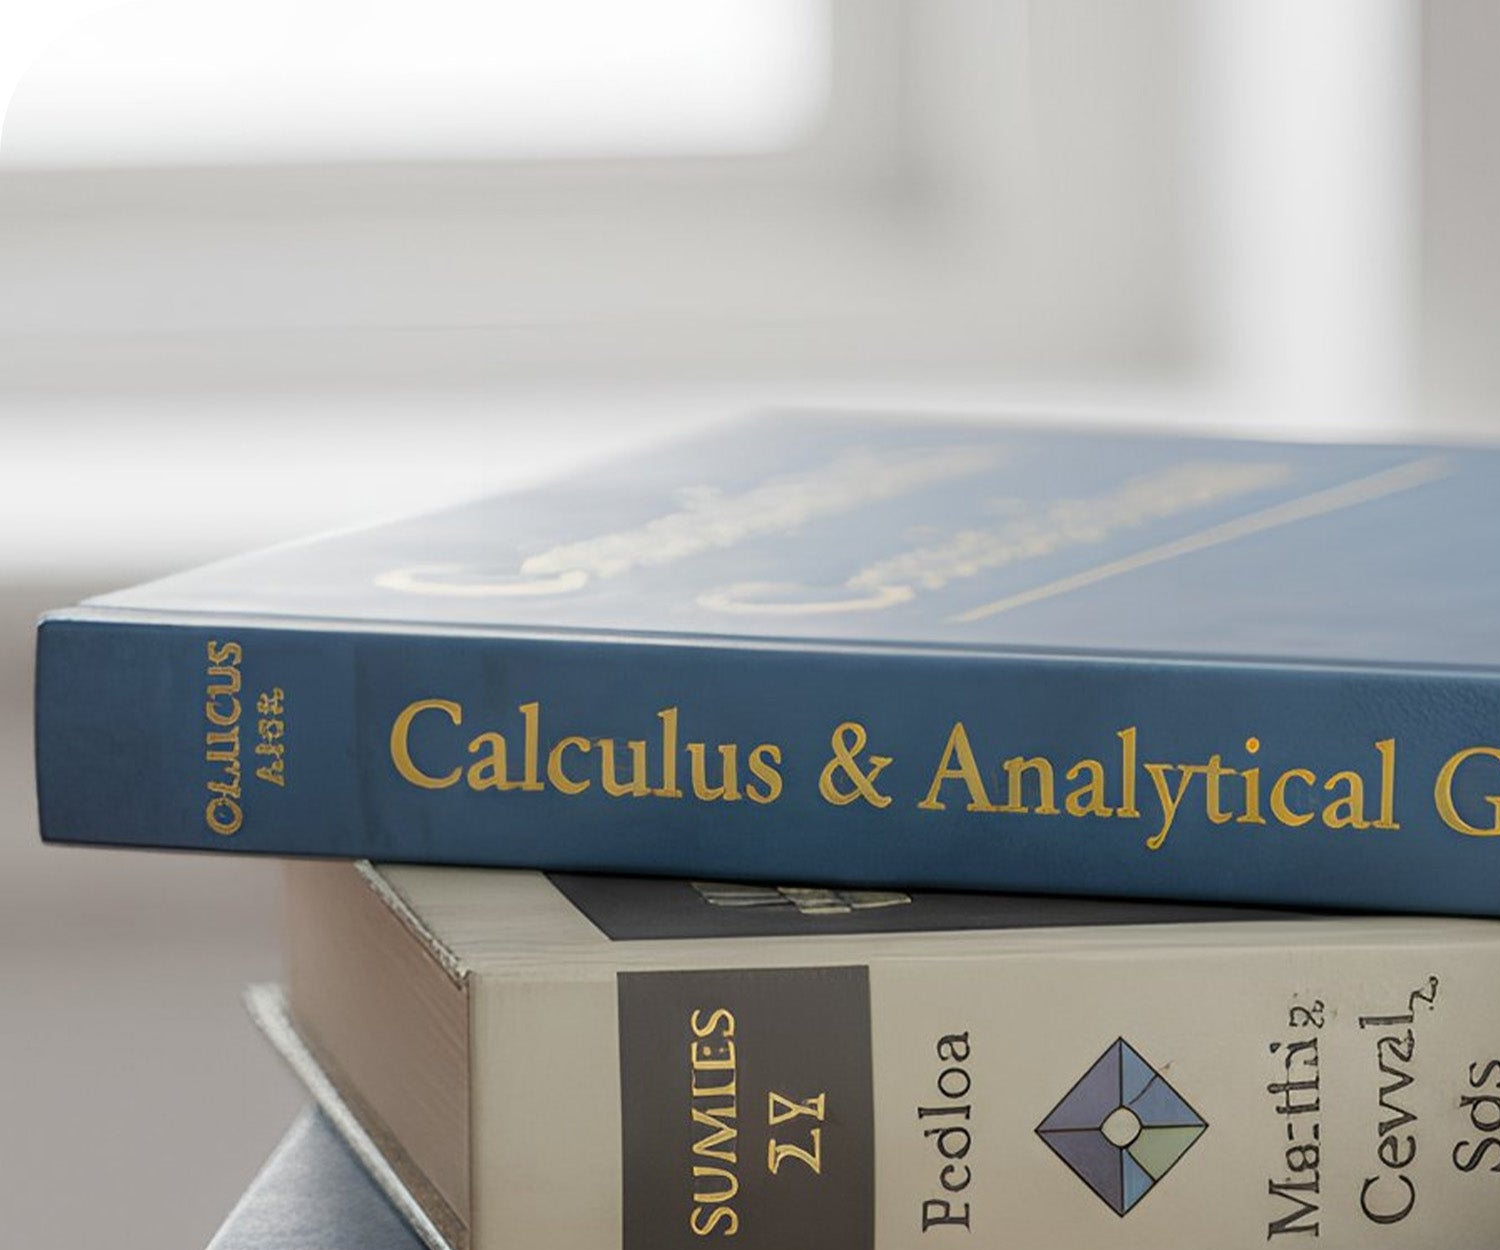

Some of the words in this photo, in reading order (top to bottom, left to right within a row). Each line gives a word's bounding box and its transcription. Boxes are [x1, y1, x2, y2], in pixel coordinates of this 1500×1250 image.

[391, 700, 782, 803] Calculus
[820, 722, 892, 808] &
[919, 723, 1399, 850] Analytical
